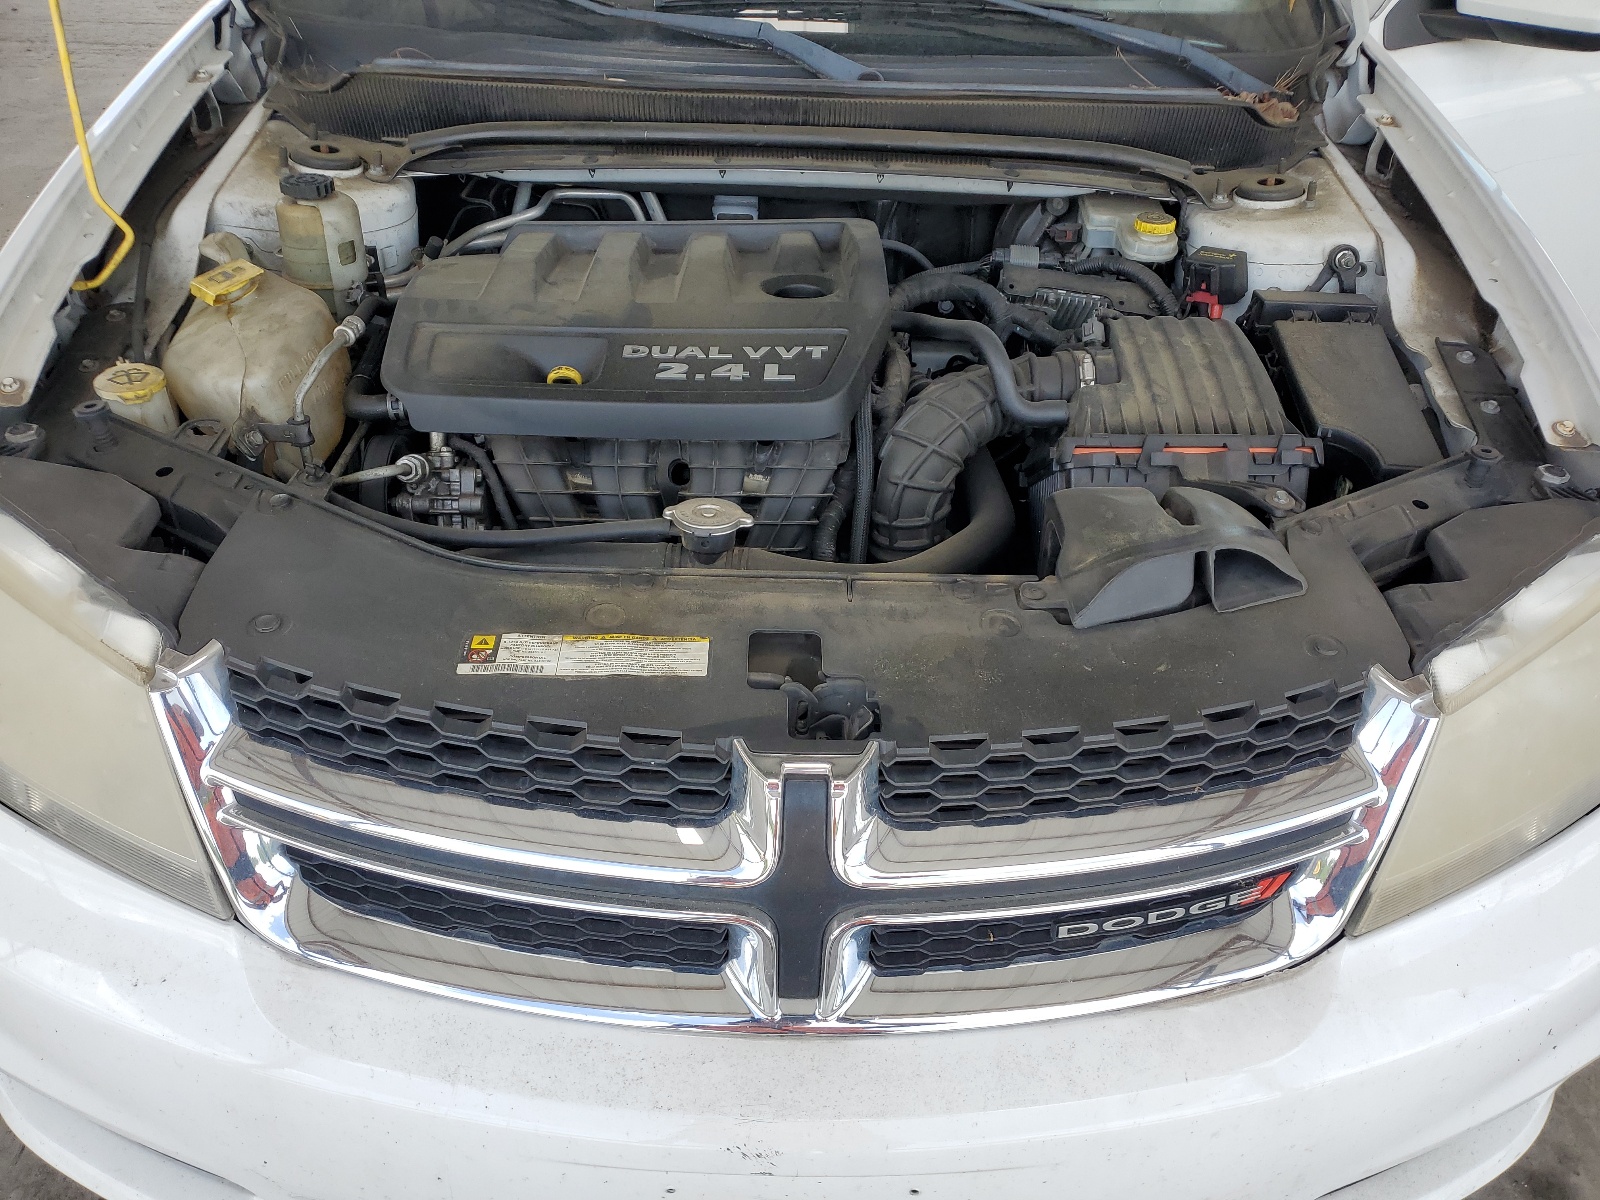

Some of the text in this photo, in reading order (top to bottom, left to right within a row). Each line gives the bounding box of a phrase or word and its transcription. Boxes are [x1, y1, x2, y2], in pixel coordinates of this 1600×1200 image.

[622, 344, 829, 360] DUAL VVT
[1057, 885, 1264, 938] DODGE
